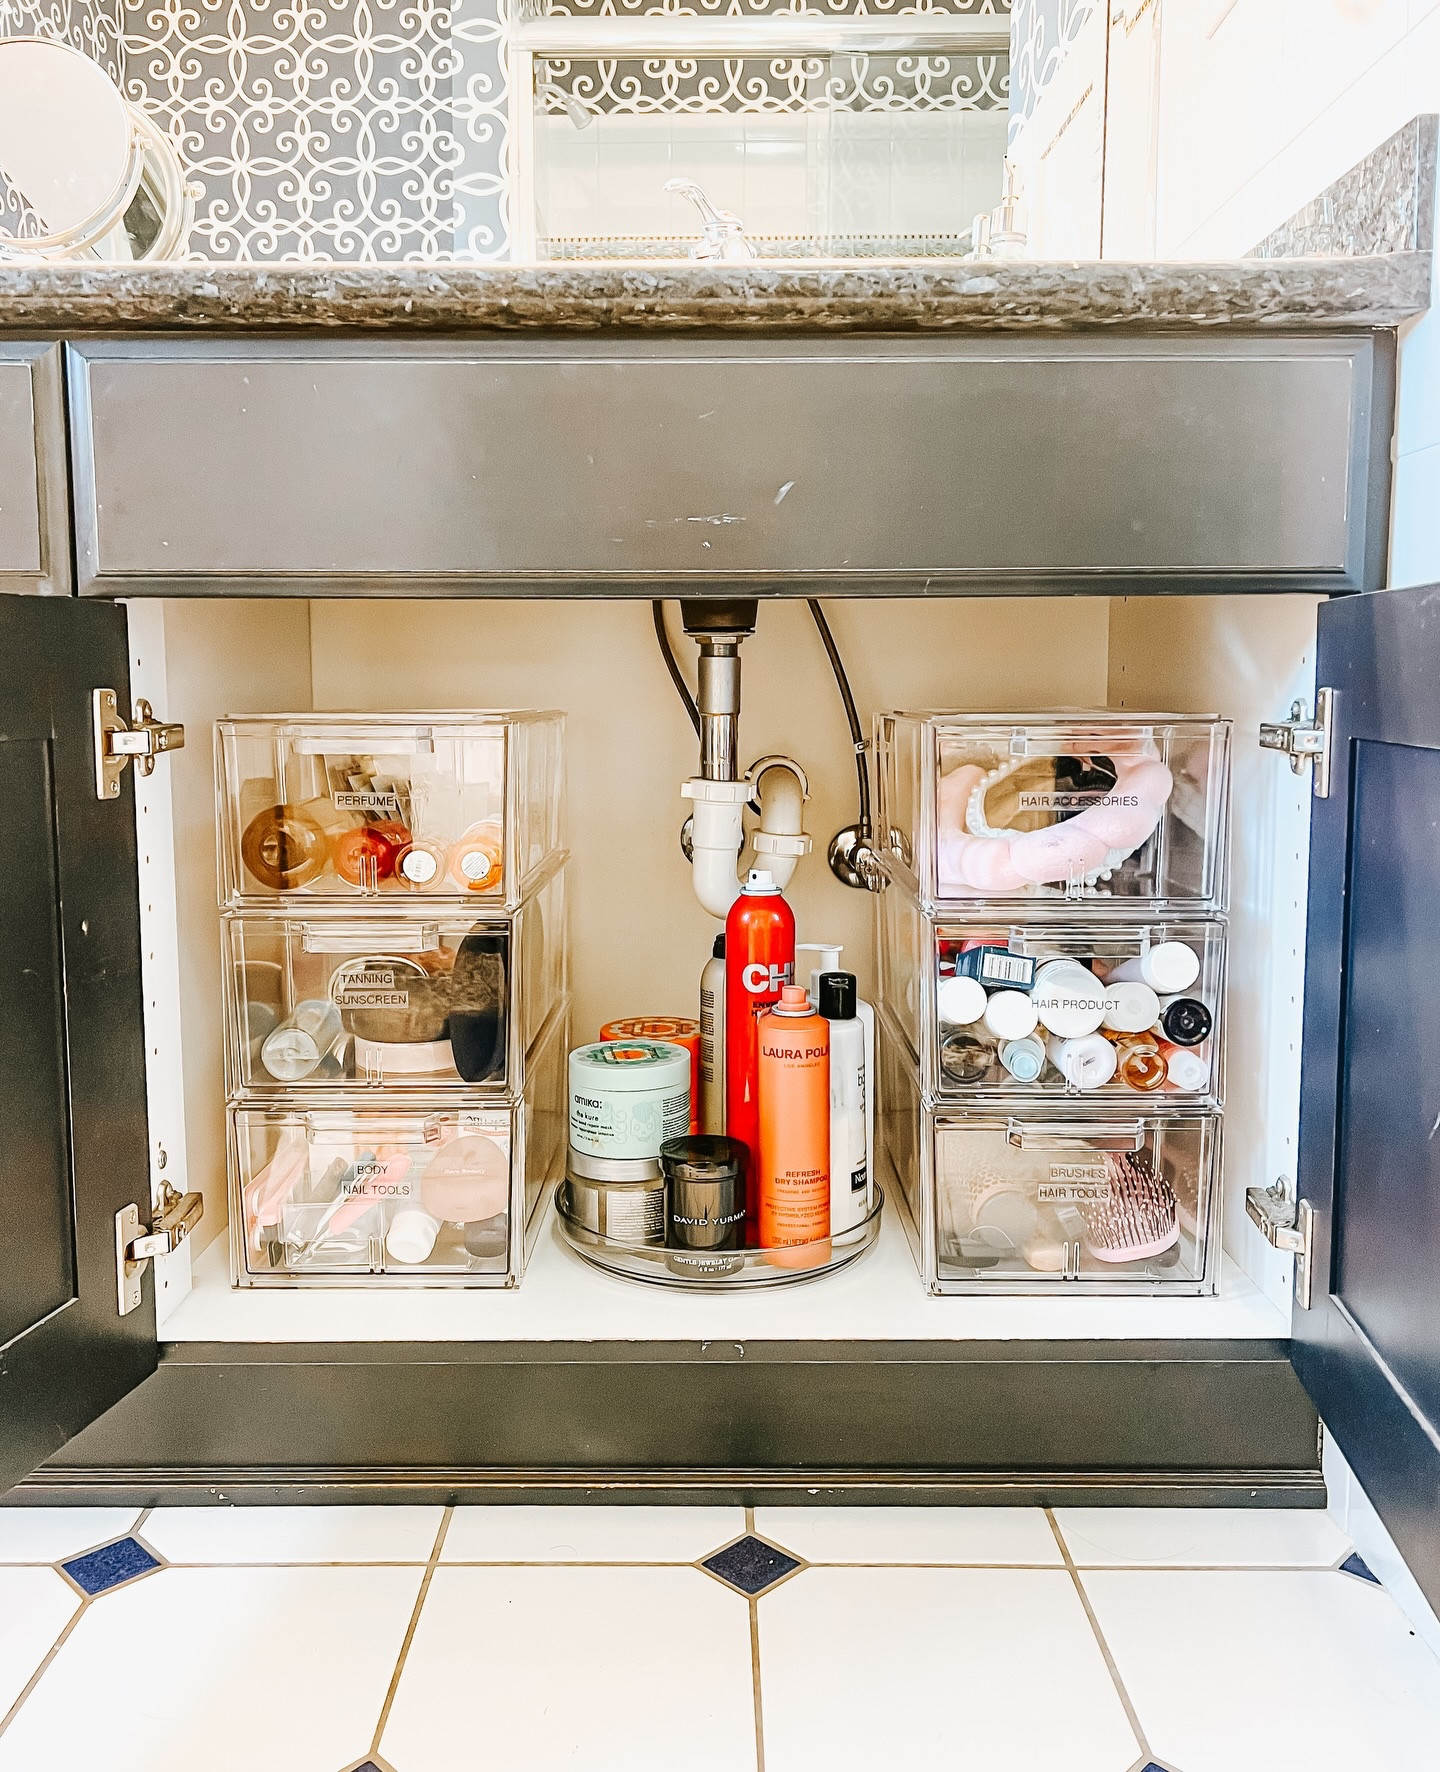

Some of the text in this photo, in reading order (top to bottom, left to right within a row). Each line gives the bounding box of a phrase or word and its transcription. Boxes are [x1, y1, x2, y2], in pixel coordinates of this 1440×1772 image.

[337, 795, 394, 806] PERFUME
[1021, 796, 1139, 807] HAIR ACCESSORIES
[341, 974, 392, 984] TANNING
[335, 995, 407, 1005] SUNSCREEN
[1031, 999, 1120, 1010] HAIR PRODUCT
[763, 1046, 803, 1060] LAURA
[357, 1165, 388, 1175] BODY
[786, 1169, 821, 1178] REFRESH
[1051, 1168, 1106, 1178] BRUSHES
[775, 1174, 828, 1186] DRY SHAMPOO
[343, 1185, 410, 1195] NAIL TOOLS
[1040, 1187, 1109, 1199] HAIR TOOLS
[673, 1209, 746, 1226] DAVID YURMA
